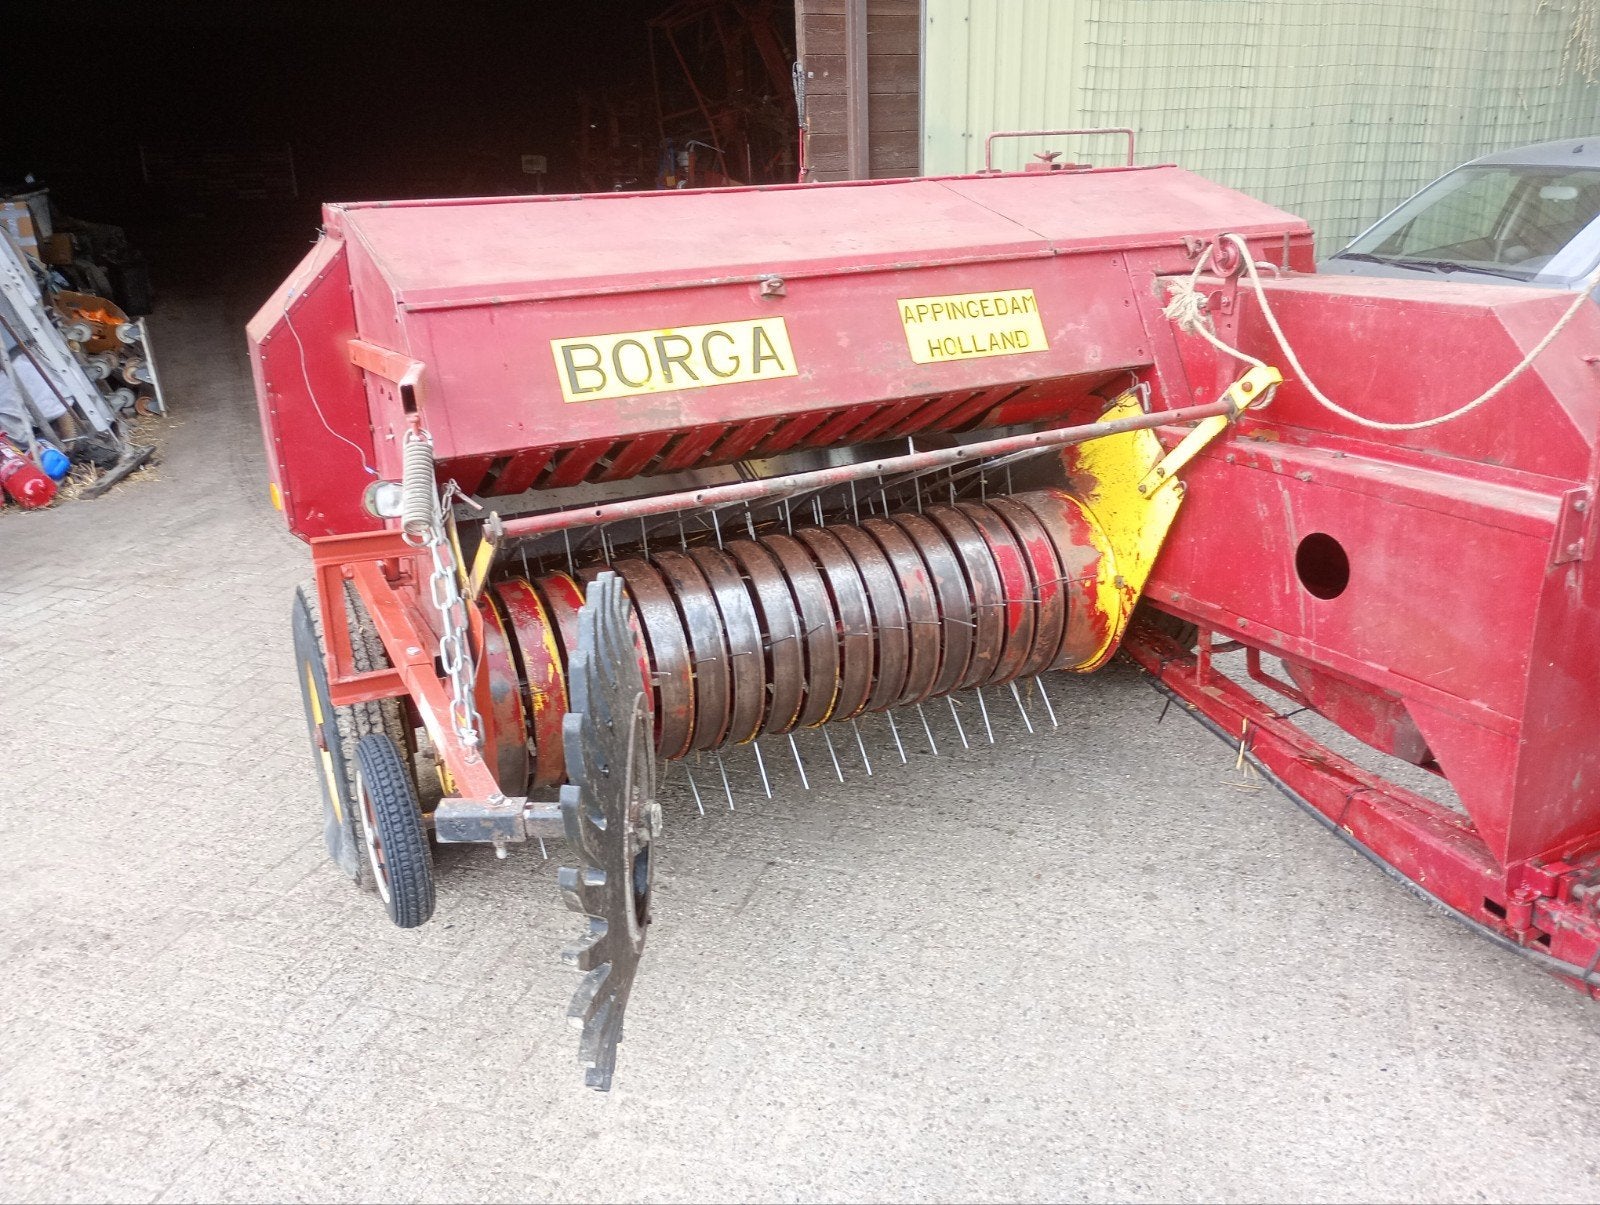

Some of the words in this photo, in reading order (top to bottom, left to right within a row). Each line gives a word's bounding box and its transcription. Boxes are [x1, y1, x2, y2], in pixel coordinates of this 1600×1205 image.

[904, 295, 1037, 324] APPINGEDAM
[928, 330, 1029, 357] HOLLAND
[562, 326, 785, 394] BORGA
